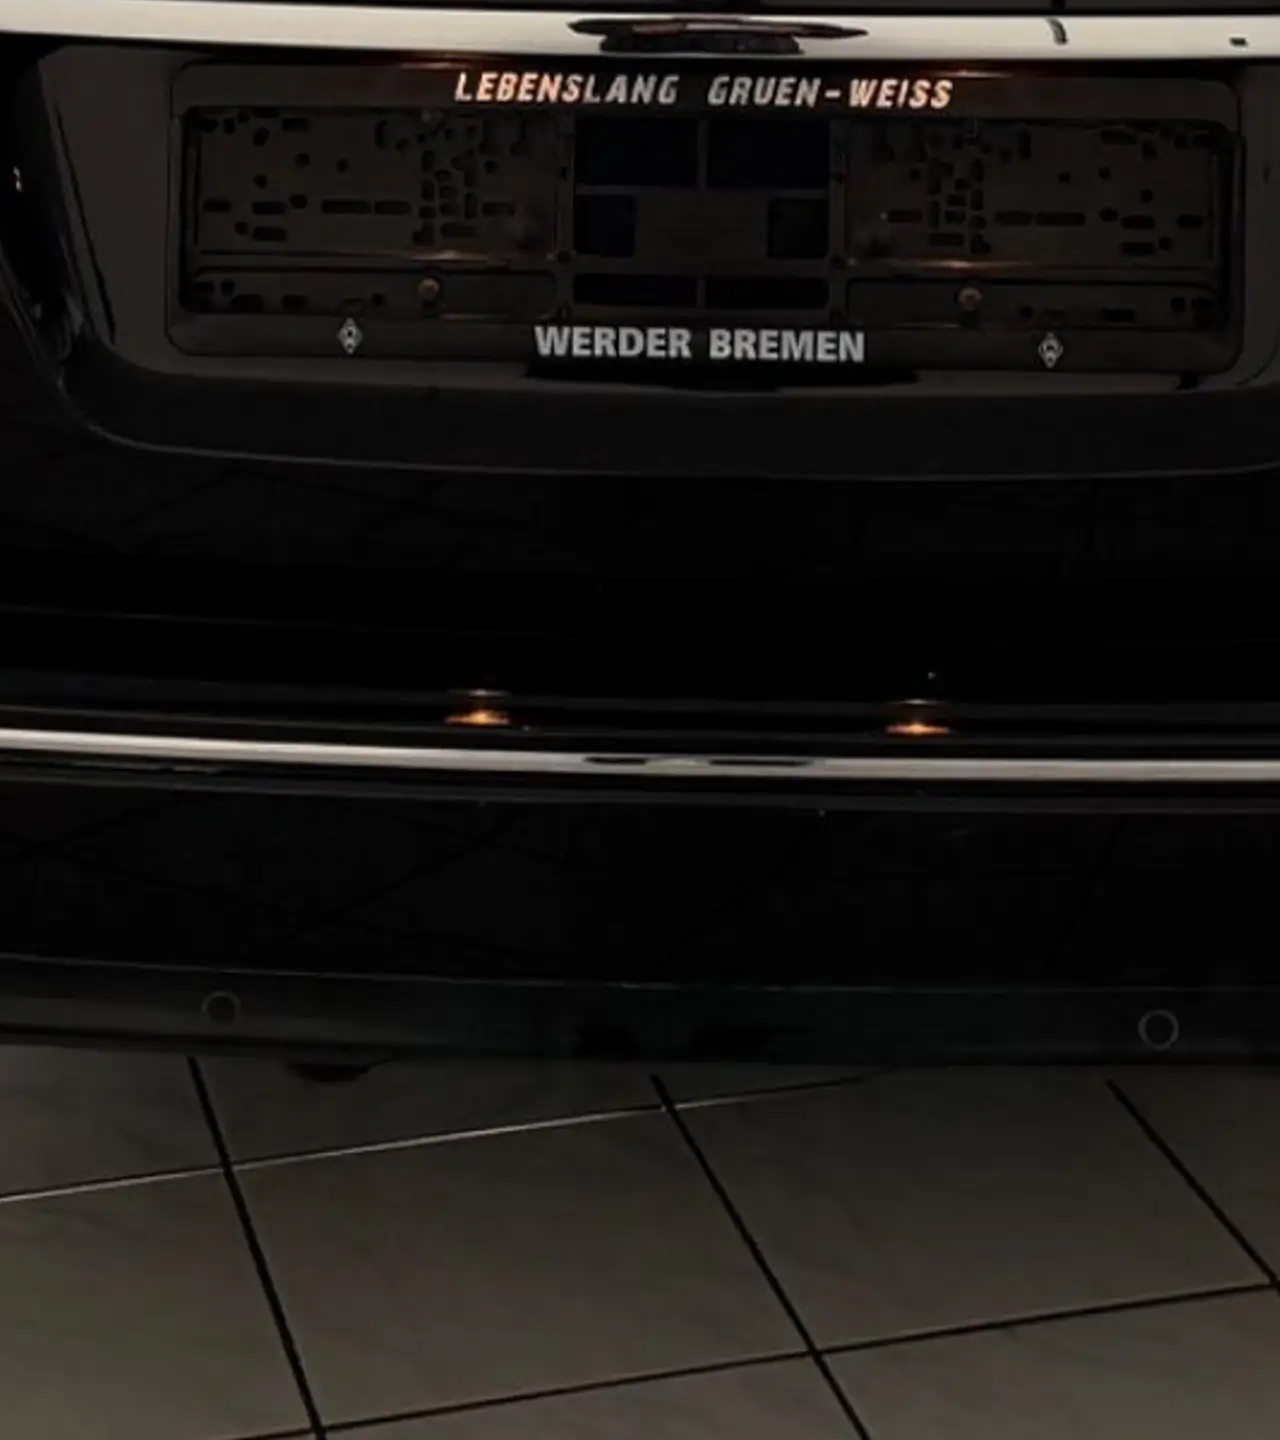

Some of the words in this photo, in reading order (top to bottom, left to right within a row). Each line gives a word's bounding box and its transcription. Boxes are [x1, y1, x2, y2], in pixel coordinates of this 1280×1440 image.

[454, 71, 680, 105] LEBENSLANG
[706, 75, 954, 110] GRUEN-WEISS
[534, 325, 692, 359] WERDER
[709, 328, 865, 363] BREMEN
